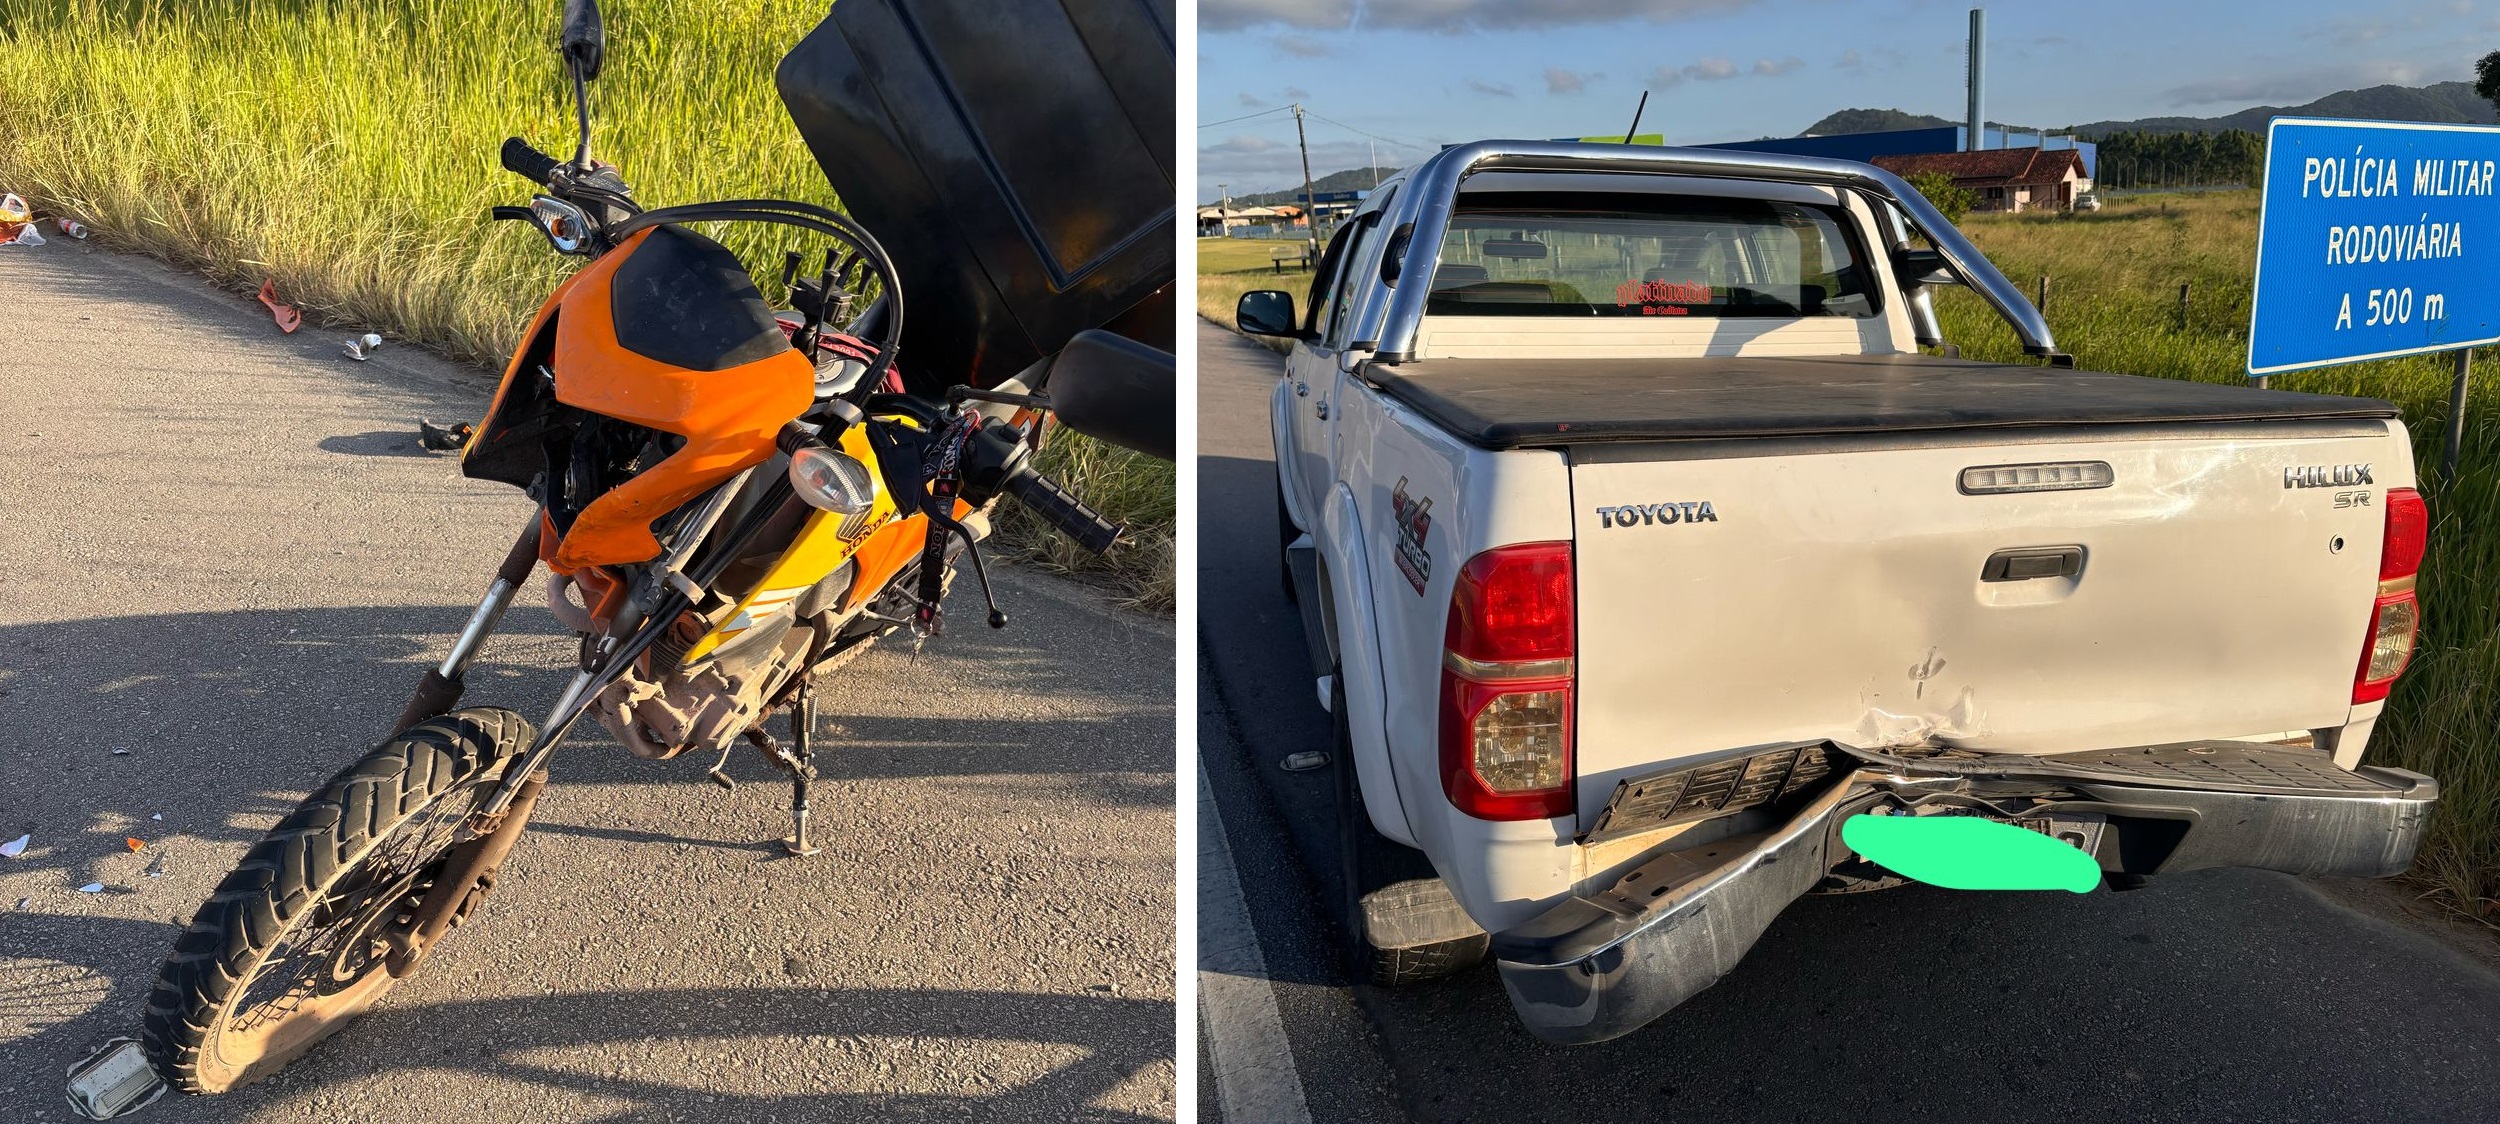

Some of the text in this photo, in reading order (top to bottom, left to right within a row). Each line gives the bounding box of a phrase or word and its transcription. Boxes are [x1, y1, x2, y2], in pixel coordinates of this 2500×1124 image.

[2302, 145, 2495, 198] POLÍCIA MILITAR
[2327, 213, 2462, 265] RODOVIÁRIA
[2335, 287, 2444, 331] A 500 m
[2284, 463, 2373, 489] HILUX
[2333, 490, 2371, 509] SR
[840, 509, 890, 560] HONDA
[1596, 501, 1718, 528] TOYOTA
[1398, 524, 1432, 581] TURBO
